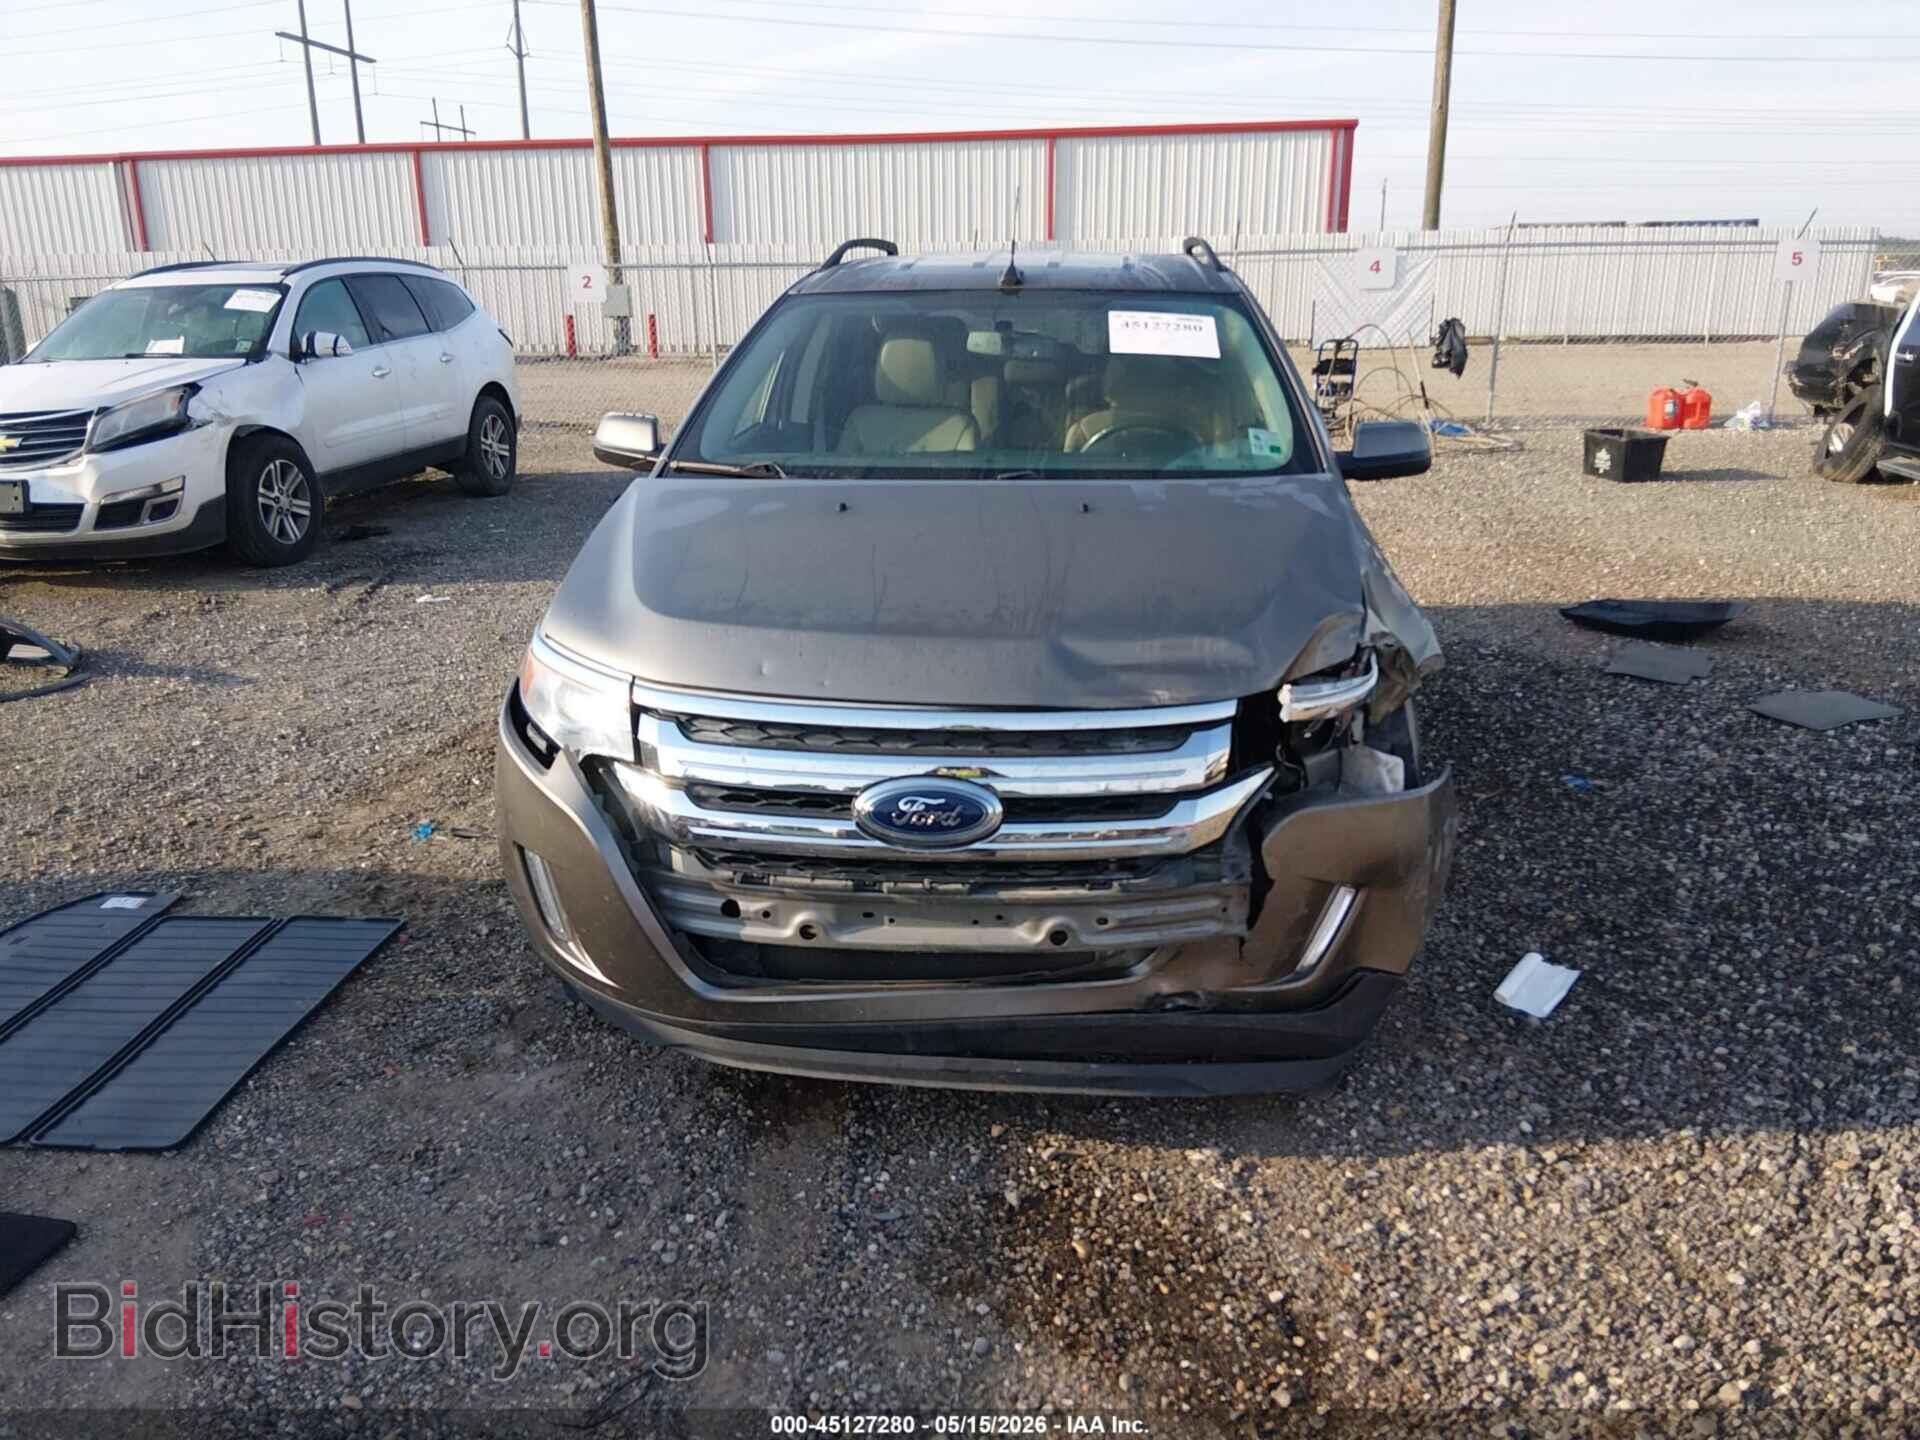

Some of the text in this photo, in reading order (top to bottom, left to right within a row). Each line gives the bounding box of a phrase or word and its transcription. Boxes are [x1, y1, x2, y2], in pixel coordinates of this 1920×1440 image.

[1791, 251, 1803, 266] 5
[1369, 259, 1382, 274] 4
[581, 274, 593, 289] 2
[1121, 320, 1203, 333] 45127280
[891, 796, 963, 827] Ford
